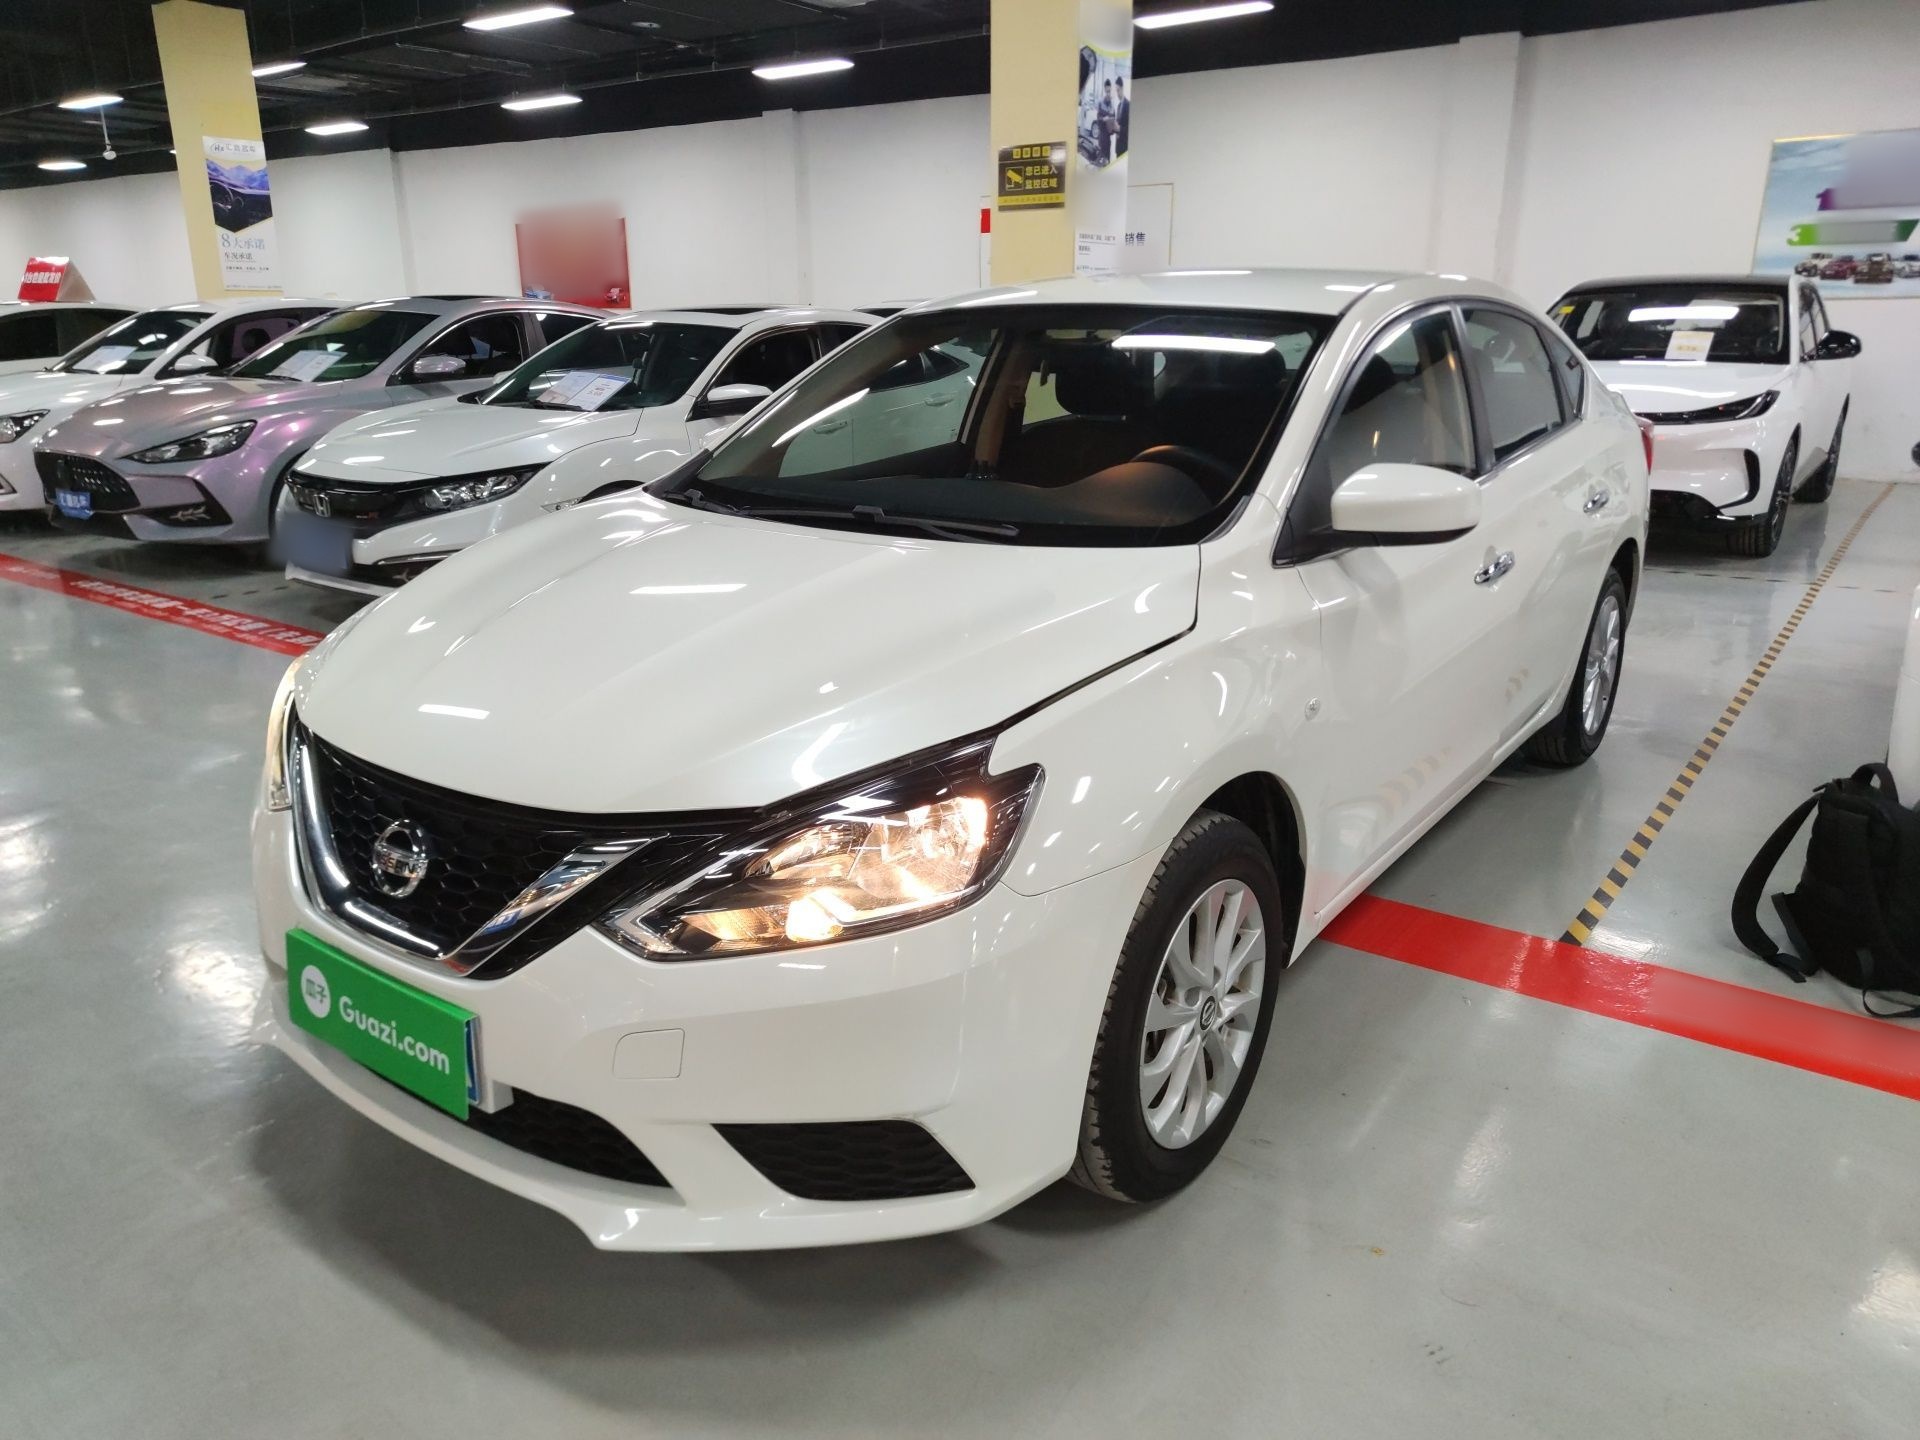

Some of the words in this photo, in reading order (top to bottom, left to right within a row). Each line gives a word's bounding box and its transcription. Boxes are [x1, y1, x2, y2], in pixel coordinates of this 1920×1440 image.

[1025, 165, 1058, 177] 您已进入
[1025, 178, 1058, 189] 监控区域
[339, 995, 450, 1075] Guazi.com
